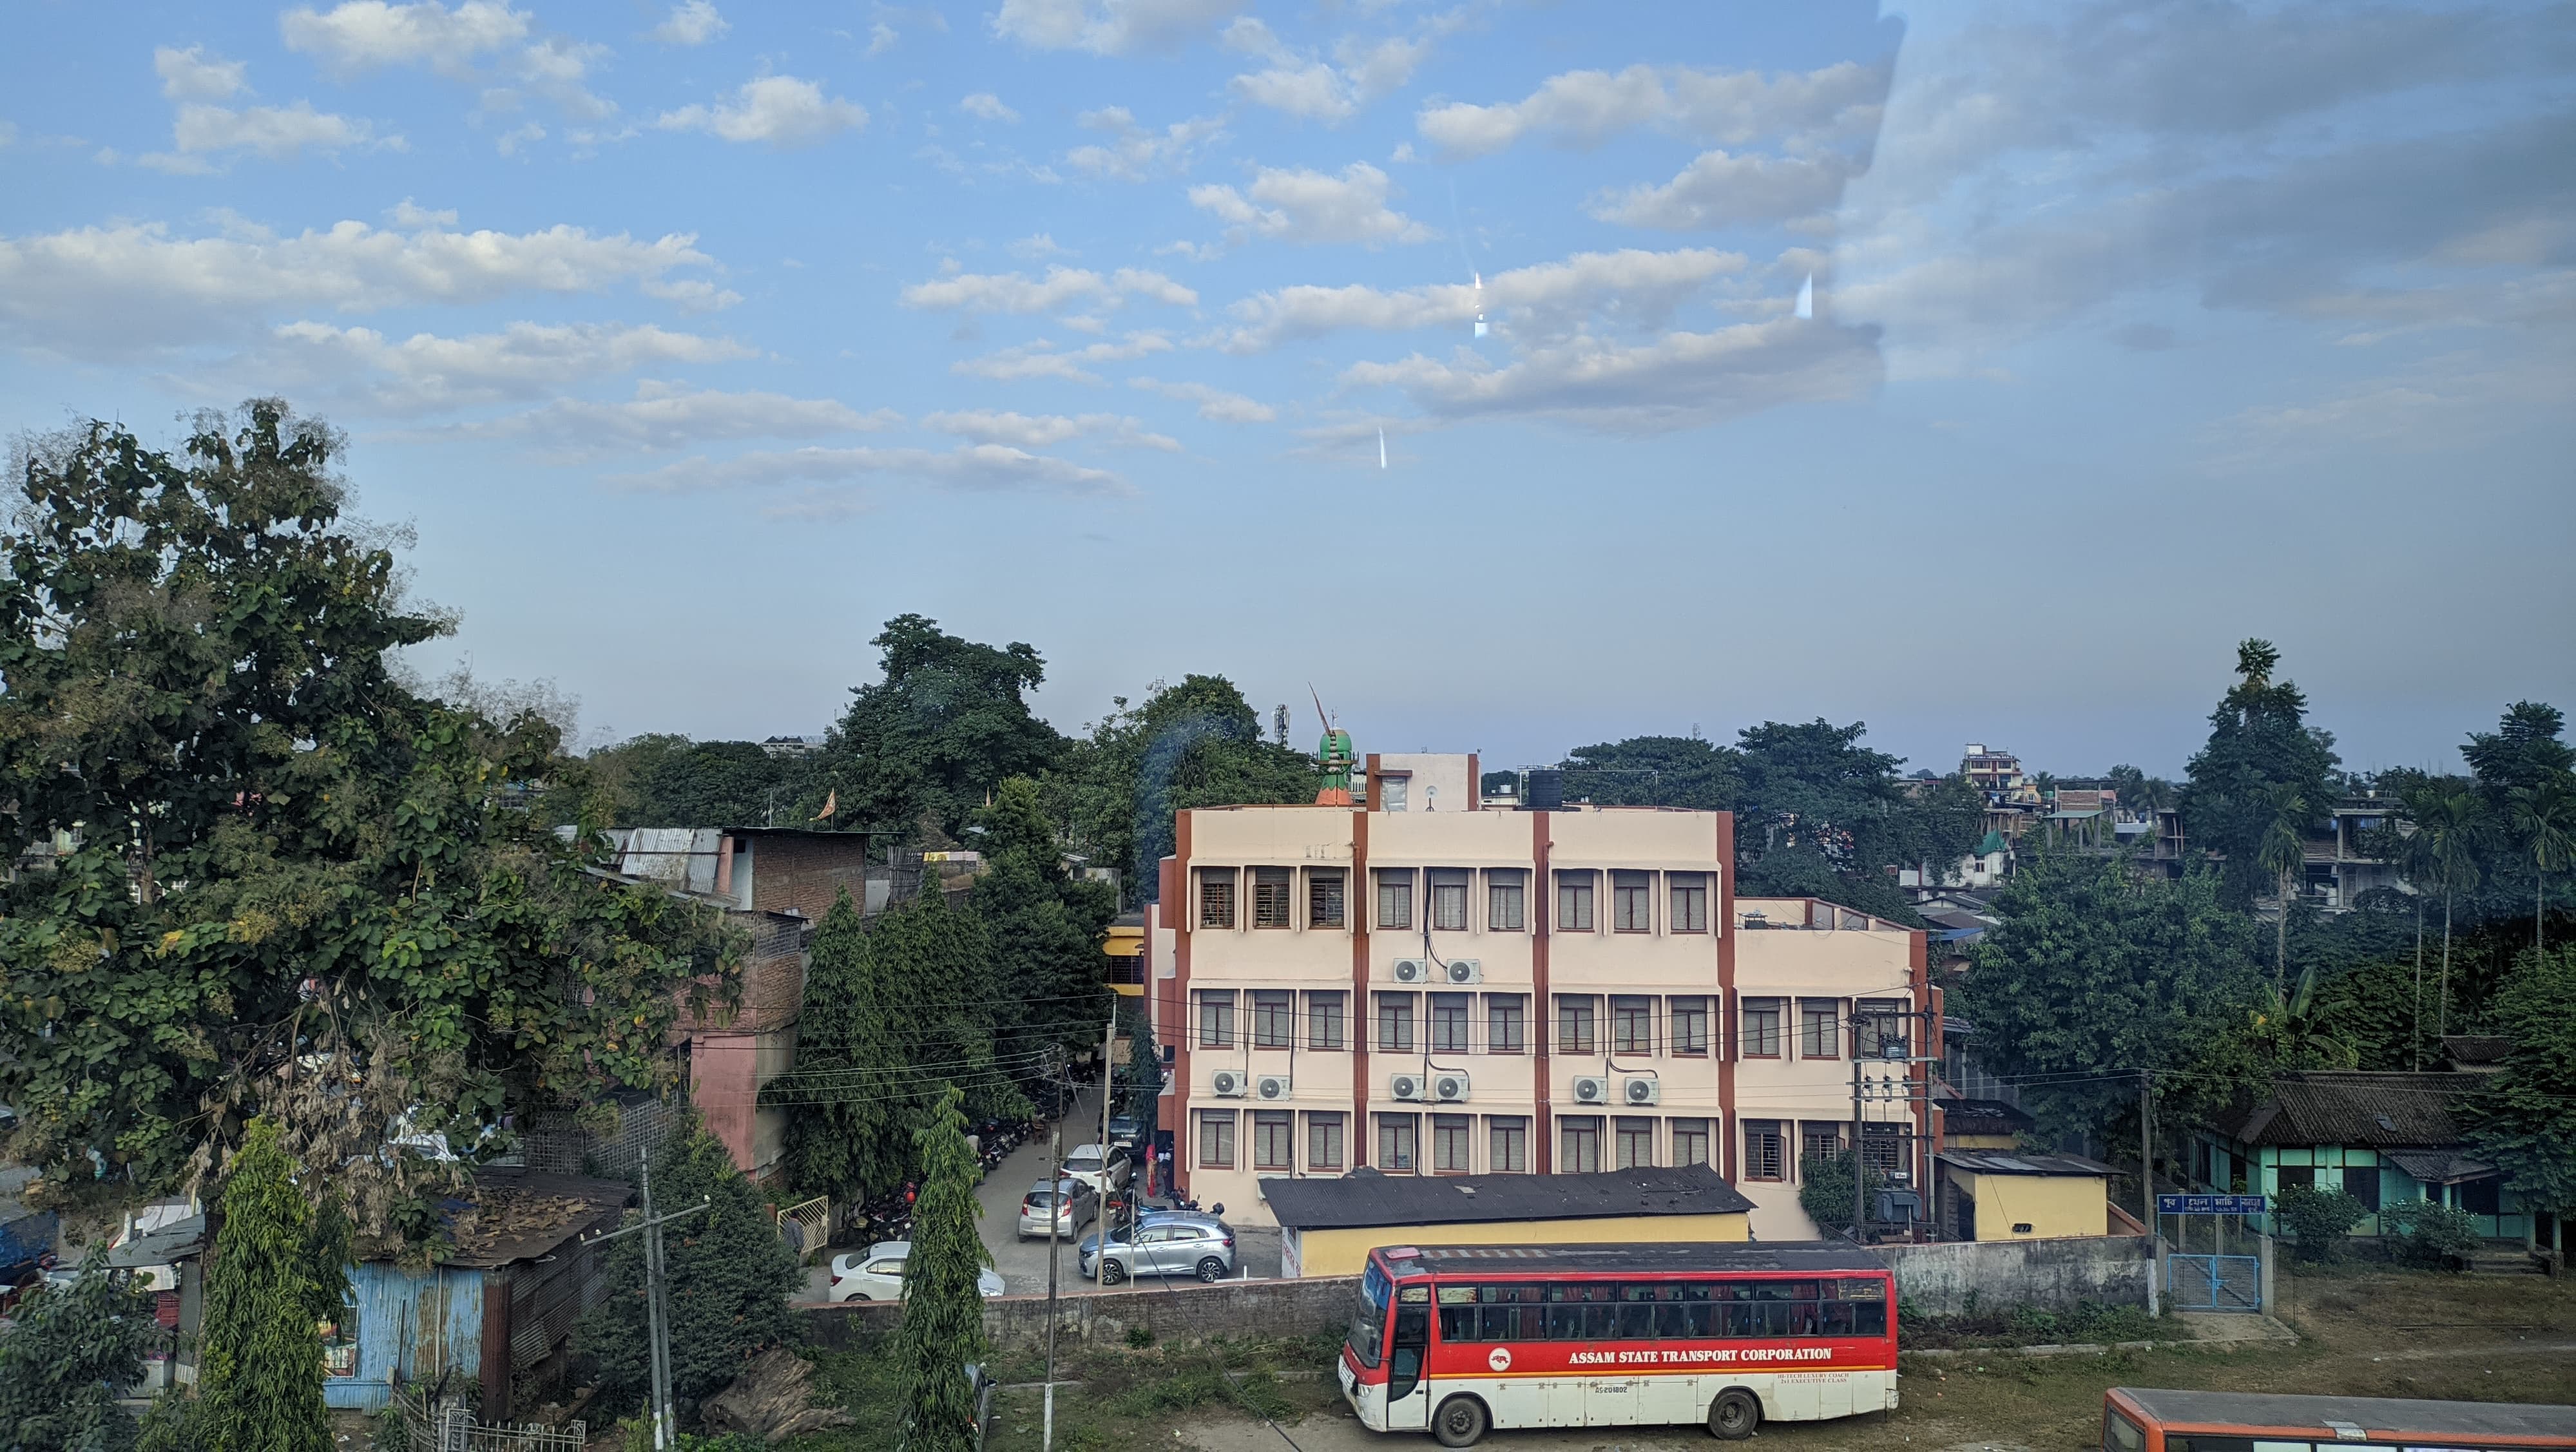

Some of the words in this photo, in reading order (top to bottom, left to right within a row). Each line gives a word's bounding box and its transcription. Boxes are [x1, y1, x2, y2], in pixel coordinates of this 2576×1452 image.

[1568, 1352, 1615, 1364] ASSAM
[1619, 1351, 1658, 1363] STATE
[1661, 1350, 1738, 1362] TRANSPORT
[1740, 1348, 1832, 1361] CORPORATION
